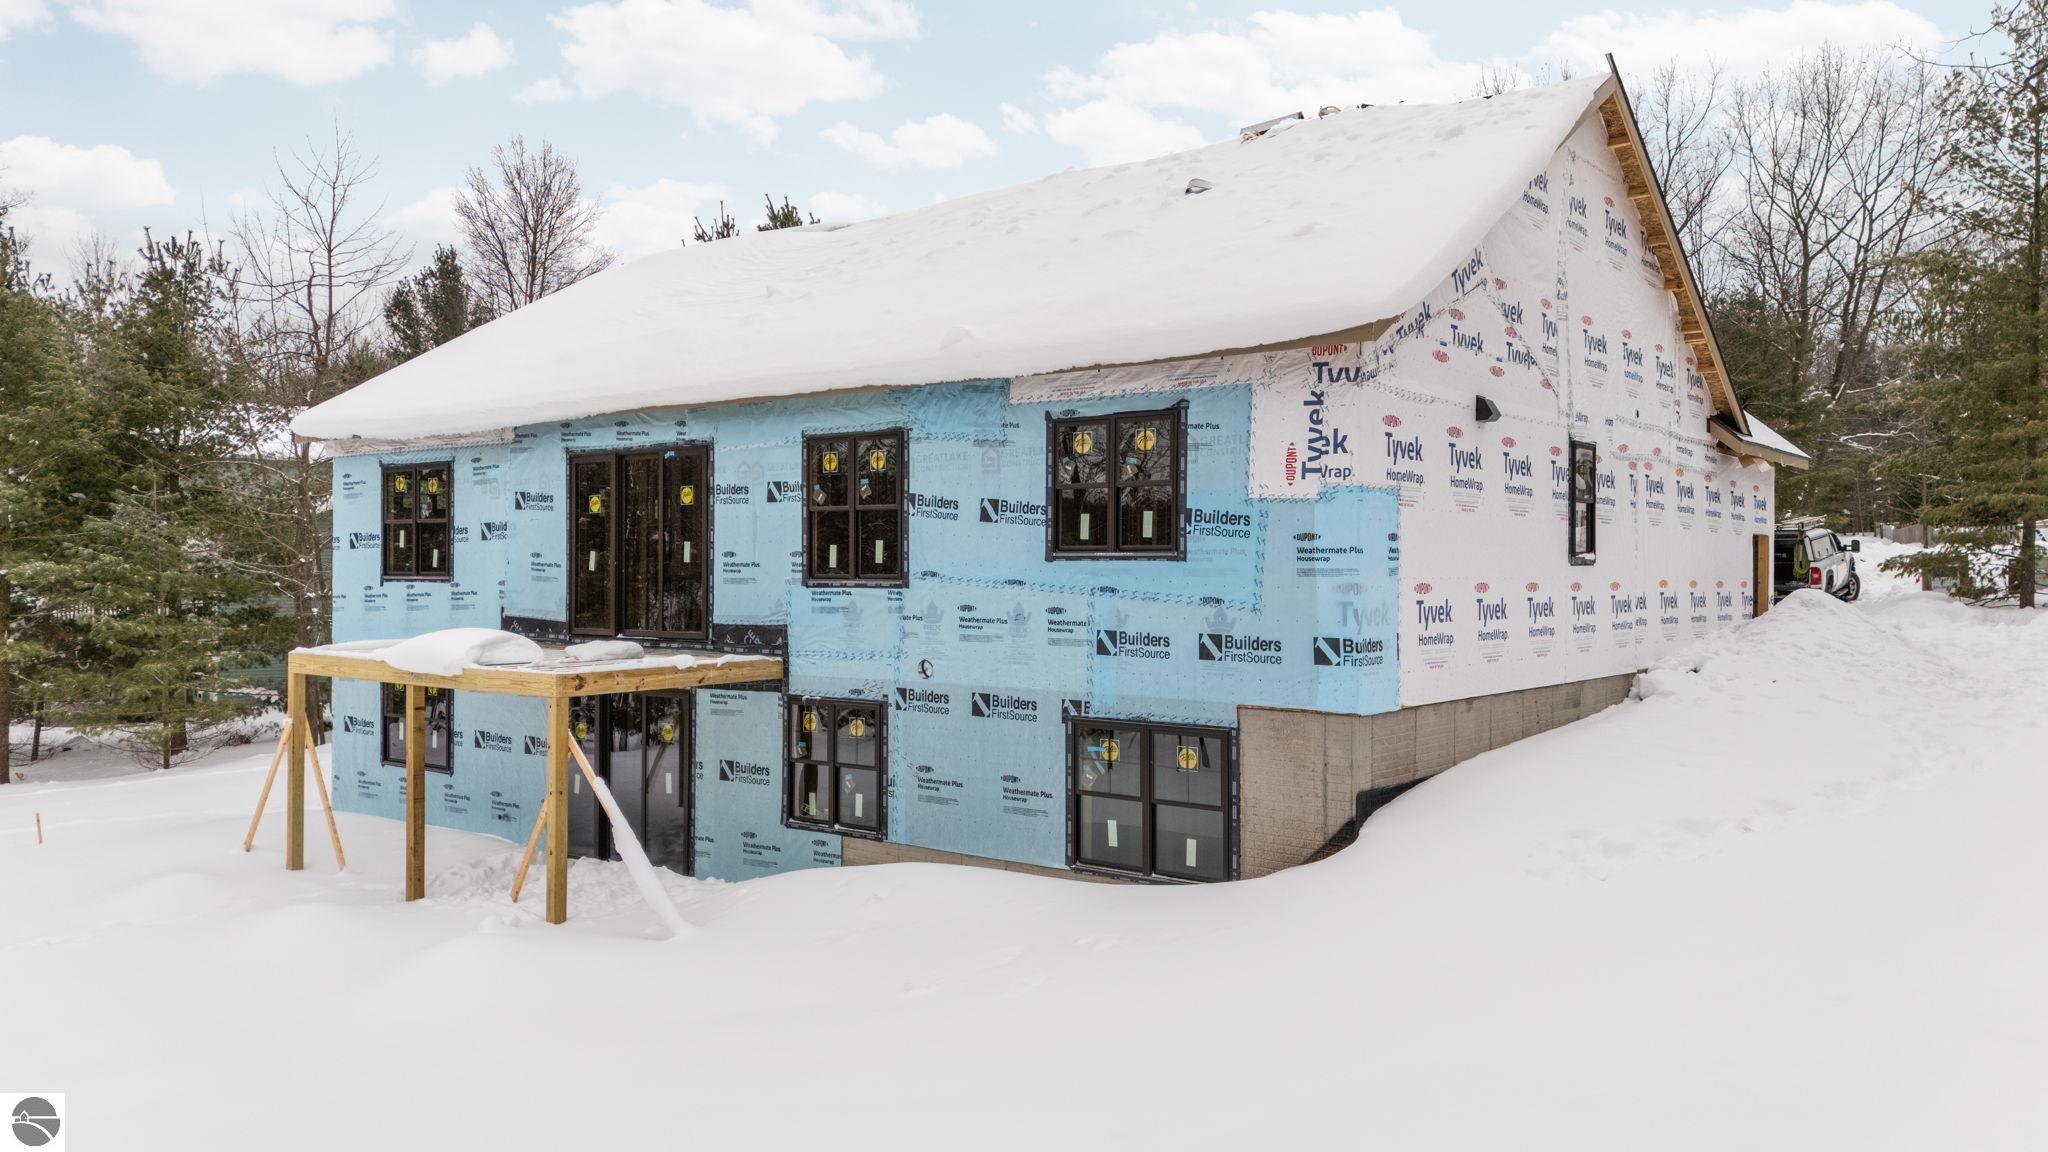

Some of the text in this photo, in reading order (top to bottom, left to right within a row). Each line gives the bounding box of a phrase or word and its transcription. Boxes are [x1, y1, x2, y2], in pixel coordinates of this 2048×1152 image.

[1529, 171, 1548, 194] vek
[1569, 197, 1586, 218] yvek
[1605, 209, 1626, 238] Tyvek
[1452, 248, 1483, 295] Tyvek
[1502, 302, 1523, 324] vek
[1542, 312, 1558, 340] Tyv
[1583, 329, 1608, 355] Tyvek
[1622, 342, 1643, 366] Tyvek
[1585, 357, 1607, 372] HomeWrap
[1687, 368, 1703, 390] Tyvek
[1301, 390, 1325, 480] Tyvek
[1385, 432, 1423, 465] Tyvek
[1286, 447, 1297, 481] DUPONT
[1449, 443, 1482, 473] Tyvek
[1503, 452, 1532, 480] Tyvek
[1387, 468, 1424, 486] HomeWrap
[1551, 460, 1569, 486] Tyve
[1596, 470, 1615, 492] yvek
[716, 484, 749, 495] Builders
[1450, 476, 1483, 491] HomeWrap
[1504, 483, 1532, 498] HomeWrap
[1645, 474, 1664, 497] Tyvek
[1676, 480, 1694, 503] Tyvek
[526, 491, 554, 503] Builders
[716, 496, 749, 504] FirstSource
[782, 494, 801, 502] FirstS
[917, 495, 958, 511] Builders
[1705, 486, 1721, 507] Tyvek
[1730, 491, 1744, 510] Tyvek
[526, 503, 554, 511] FirstSource
[916, 508, 958, 521] FirstSource
[1000, 501, 1046, 516] Builders
[1000, 514, 1046, 527] FirstSource
[1193, 509, 1250, 526] Builders
[454, 526, 469, 535] ders
[491, 522, 507, 532] Build
[1193, 525, 1250, 539] FirstSource
[359, 532, 380, 541] Builders
[1294, 532, 1320, 541] DUPONT
[1572, 595, 1596, 622] Tyvek
[1611, 594, 1632, 619] Tyvek
[1660, 592, 1678, 614] Tyvek
[1690, 592, 1706, 613] Tyvek
[1717, 592, 1732, 611] Tyvek
[1742, 592, 1753, 611] Tyve
[1416, 599, 1453, 630] Tyvek
[1476, 597, 1507, 627] Tyvek
[1527, 597, 1554, 624] Tyvek
[959, 616, 992, 625] Weathermate
[1048, 619, 1086, 627] Weathermate
[1573, 623, 1596, 634] HomeWrap
[1119, 631, 1170, 647] Builders
[1418, 632, 1454, 646] HomeWrap
[1478, 630, 1508, 642] HomeWrap
[1529, 626, 1555, 638] HomeWrap
[1224, 635, 1281, 651] Builders
[1343, 638, 1383, 654] Builders
[1119, 647, 1170, 659] FirstSource
[1224, 651, 1282, 664] FirstSource
[1343, 654, 1383, 667] FirstSource
[908, 688, 949, 705] Builders
[992, 694, 1037, 711] Builders
[908, 702, 949, 715] FirstSource
[991, 708, 1037, 722] FirstSource
[354, 717, 374, 729] Builders
[486, 731, 512, 744] Builders
[486, 742, 512, 753] FirstSource
[735, 761, 770, 776] Builders
[734, 775, 770, 786] FirstSource
[918, 777, 963, 788] Weathermate Plus
[1003, 787, 1039, 798] Weathermate
[1003, 794, 1027, 803] Housewrap
